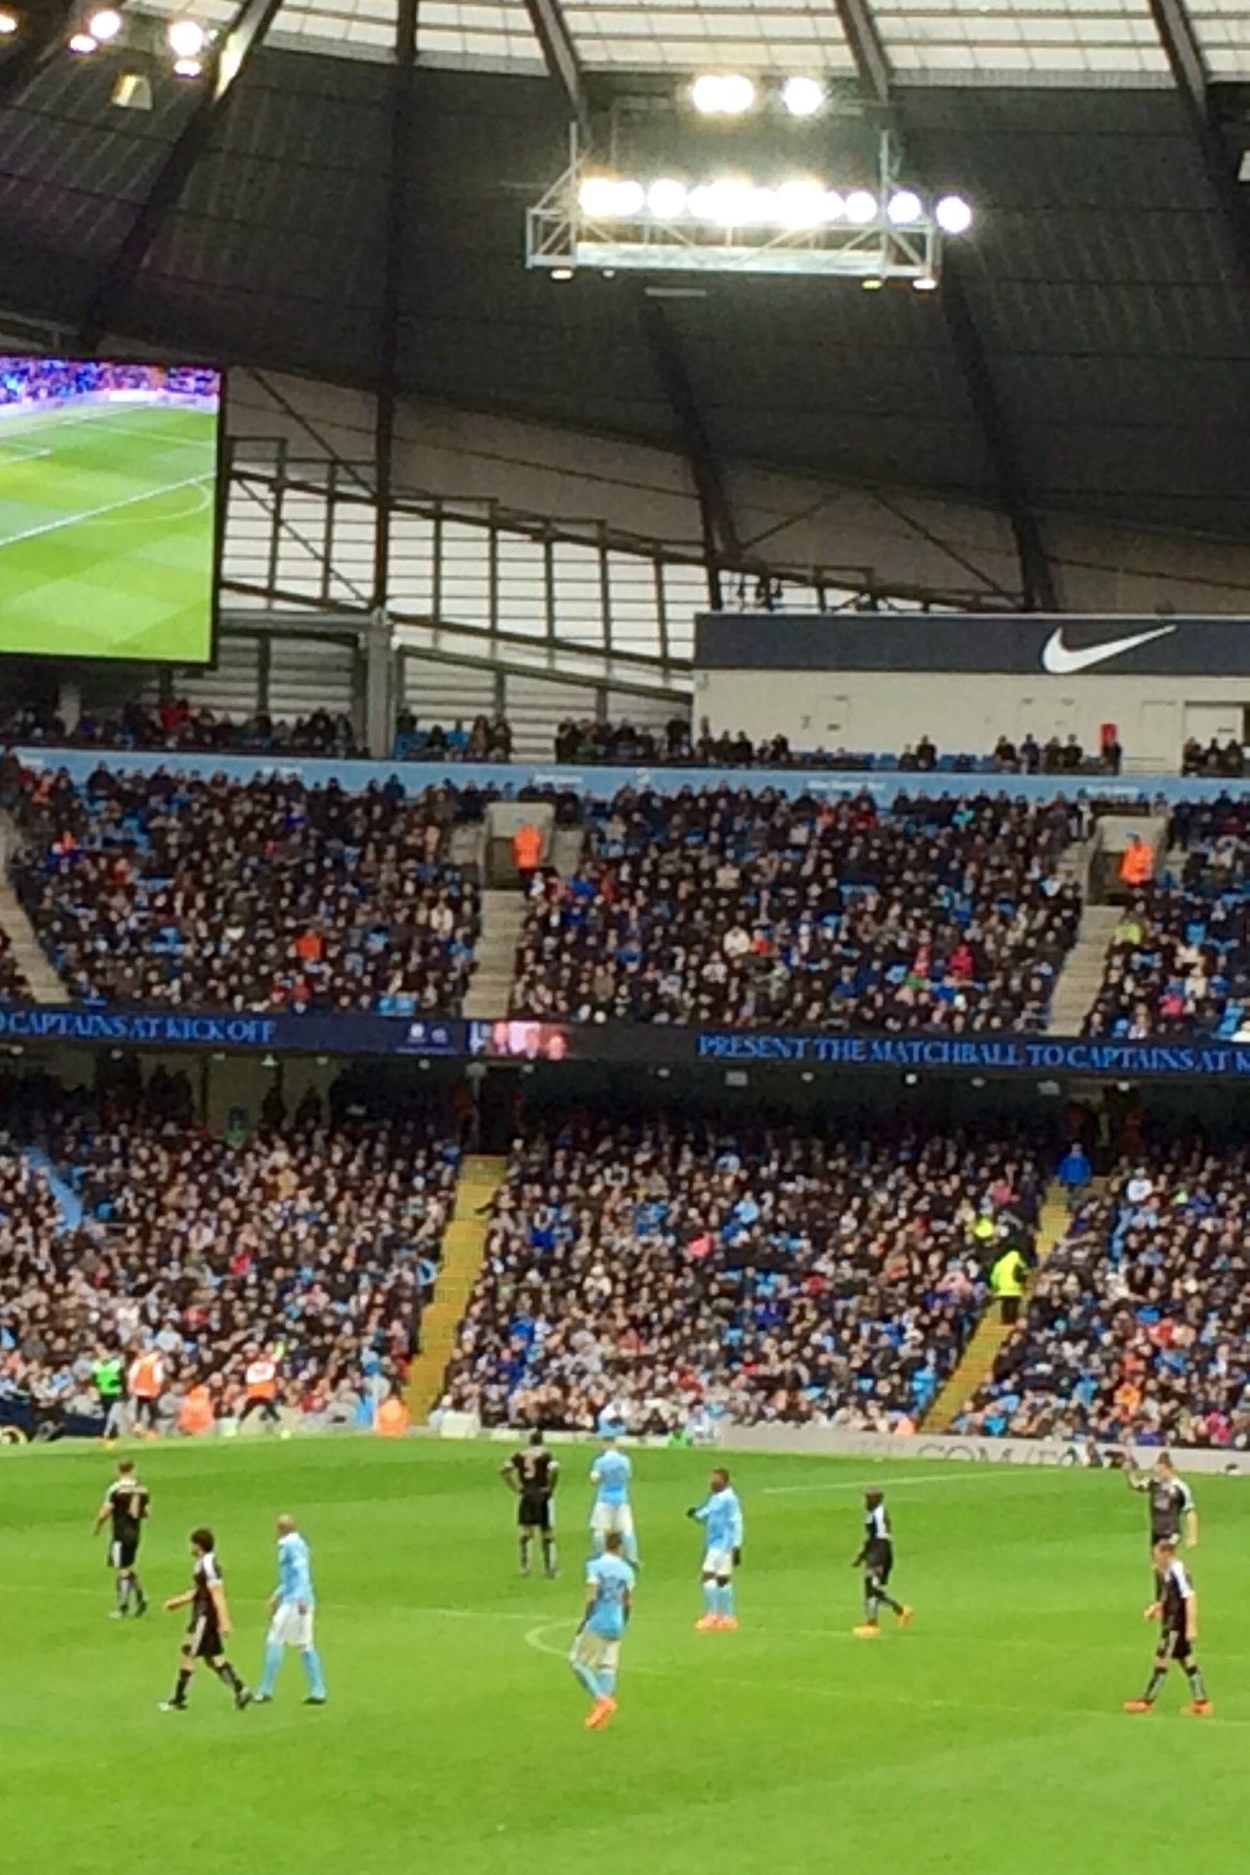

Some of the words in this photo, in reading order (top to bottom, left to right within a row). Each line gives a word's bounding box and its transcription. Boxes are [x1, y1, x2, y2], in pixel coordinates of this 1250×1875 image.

[226, 1019, 277, 1043] OFF
[697, 1034, 811, 1060] PRESENT
[813, 1038, 868, 1062] THE
[870, 1039, 1021, 1067] MATCHBALL
[1024, 1042, 1065, 1067] TO
[1066, 1045, 1195, 1072] CAPTAINS
